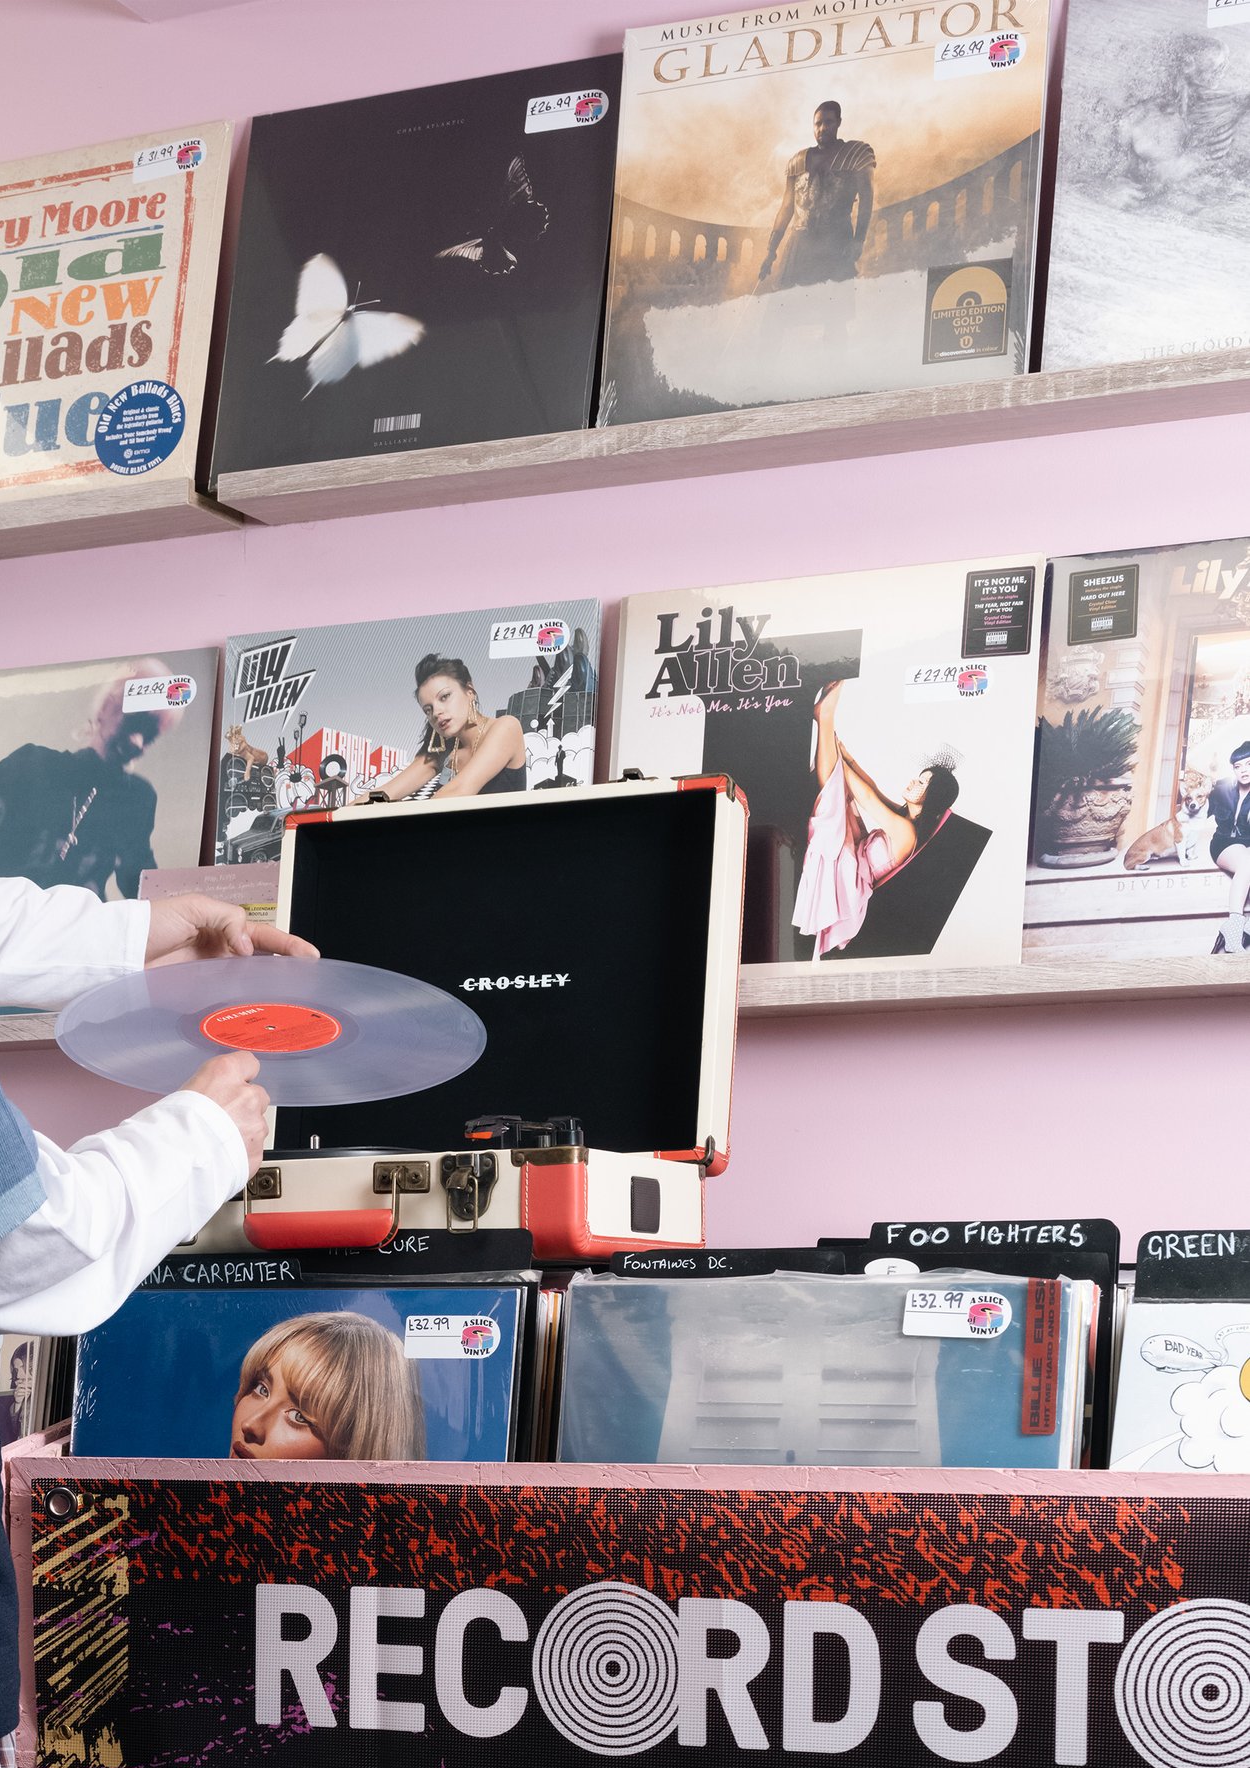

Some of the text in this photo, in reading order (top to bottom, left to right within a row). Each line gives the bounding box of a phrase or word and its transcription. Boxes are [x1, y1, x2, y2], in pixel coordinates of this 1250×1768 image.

[660, 8, 801, 42] MUSIC FROM
[652, 0, 1025, 84] GLADIATOR
[941, 39, 985, 60] £36.99
[991, 58, 1017, 68] VINYL
[530, 95, 571, 116] £26.99
[576, 115, 599, 123] VINYL
[41, 192, 168, 239] Moore
[7, 276, 163, 336] New
[933, 304, 1005, 320] LIMITED EDITION
[953, 315, 984, 327] GOLD
[954, 326, 981, 335] VINYL
[131, 382, 170, 398] Ballads
[974, 575, 1028, 587] IT'S NOT ME,
[1083, 574, 1125, 588] SHEEZUS
[1169, 559, 1240, 601] Lily
[982, 585, 1018, 595] IT'S YOU
[1080, 594, 1097, 602] HARD
[1110, 590, 1126, 598] HERE
[653, 605, 772, 662] Lily
[538, 645, 561, 653] VINYL
[644, 648, 802, 700] Allen
[913, 667, 957, 683] £27.99
[249, 674, 312, 720] ALLEN
[959, 689, 984, 697] VINYL
[676, 702, 704, 717] Not
[764, 695, 794, 713] You
[459, 973, 571, 991] CROSLEY
[886, 1223, 1088, 1249] FOO FIGHTERS
[1147, 1231, 1235, 1260] GREEN
[182, 1259, 295, 1284] CARPENTER
[911, 1292, 964, 1309] £32.99
[977, 1295, 1004, 1306] SLICE
[408, 1317, 450, 1331] £32.99
[469, 1318, 494, 1328] SLICE
[969, 1325, 1000, 1335] VINYL
[463, 1347, 491, 1356] VINYL
[1164, 1339, 1204, 1360] BAD YEAR
[1029, 1357, 1043, 1428] BILLIE
[255, 1583, 881, 1758] RECORD
